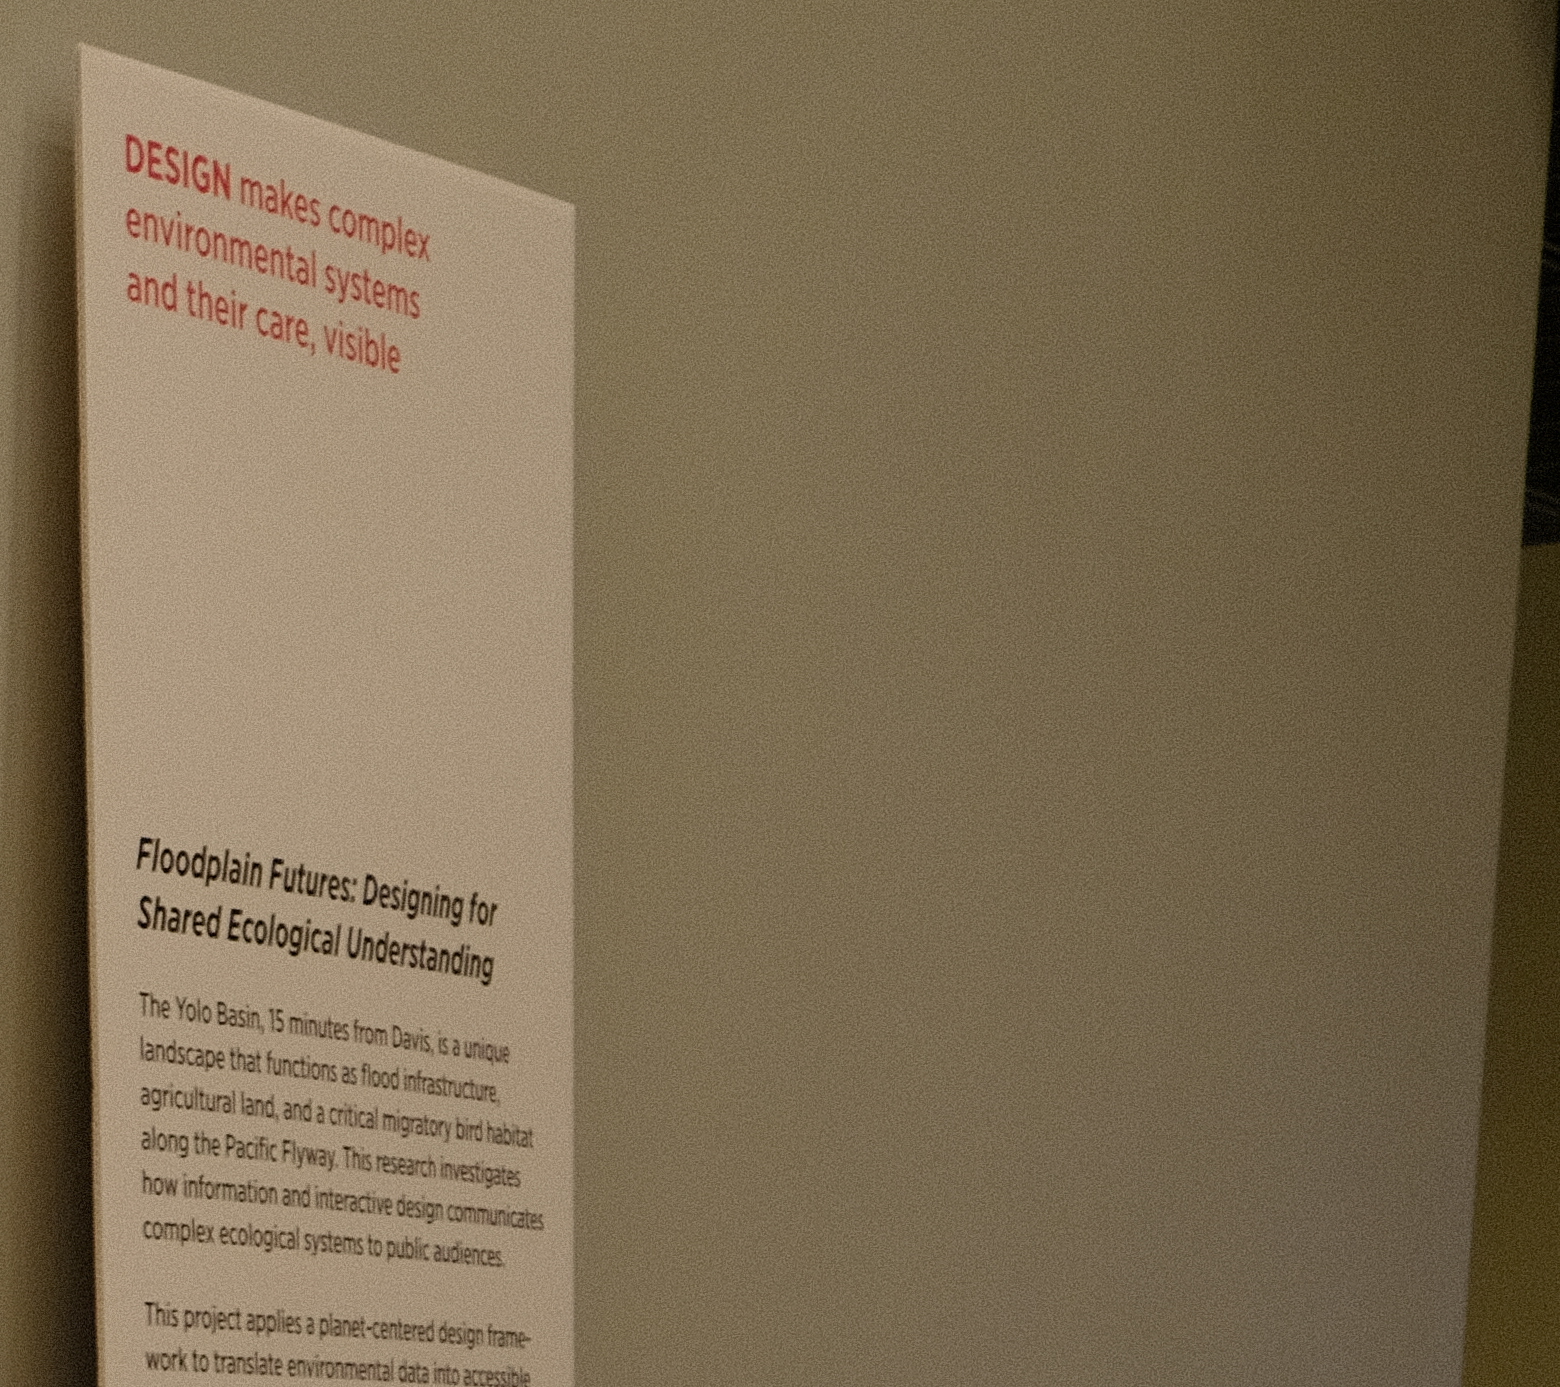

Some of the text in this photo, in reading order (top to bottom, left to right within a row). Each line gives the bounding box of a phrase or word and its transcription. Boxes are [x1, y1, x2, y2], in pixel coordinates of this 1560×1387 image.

[126, 134, 430, 261] DESIGN makes complex
[127, 207, 420, 319] environmental systems
[127, 271, 401, 373] and their care, visible
[137, 837, 497, 927] Floodplain Futures: Designing for
[138, 895, 494, 986] Shared Ecological Understanding
[139, 993, 510, 1066] The Yolo Basin, 15 minutes from Davis, is a unique
[140, 1037, 500, 1103] landscape that functions as flood infrastructure,
[141, 1084, 533, 1148] agricultural land, and a critical migratory bird habitat
[142, 1128, 189, 1158] along
[194, 1134, 219, 1155] the
[226, 1135, 277, 1162] Pacific
[343, 1147, 371, 1171] This
[376, 1154, 437, 1178] research
[441, 1159, 521, 1189] investigates
[143, 1170, 544, 1230] how information and interactive design communicates
[143, 1218, 214, 1244] complex
[220, 1224, 299, 1252] ecological
[304, 1235, 363, 1257] systems
[368, 1235, 383, 1257] to
[387, 1239, 429, 1262] public
